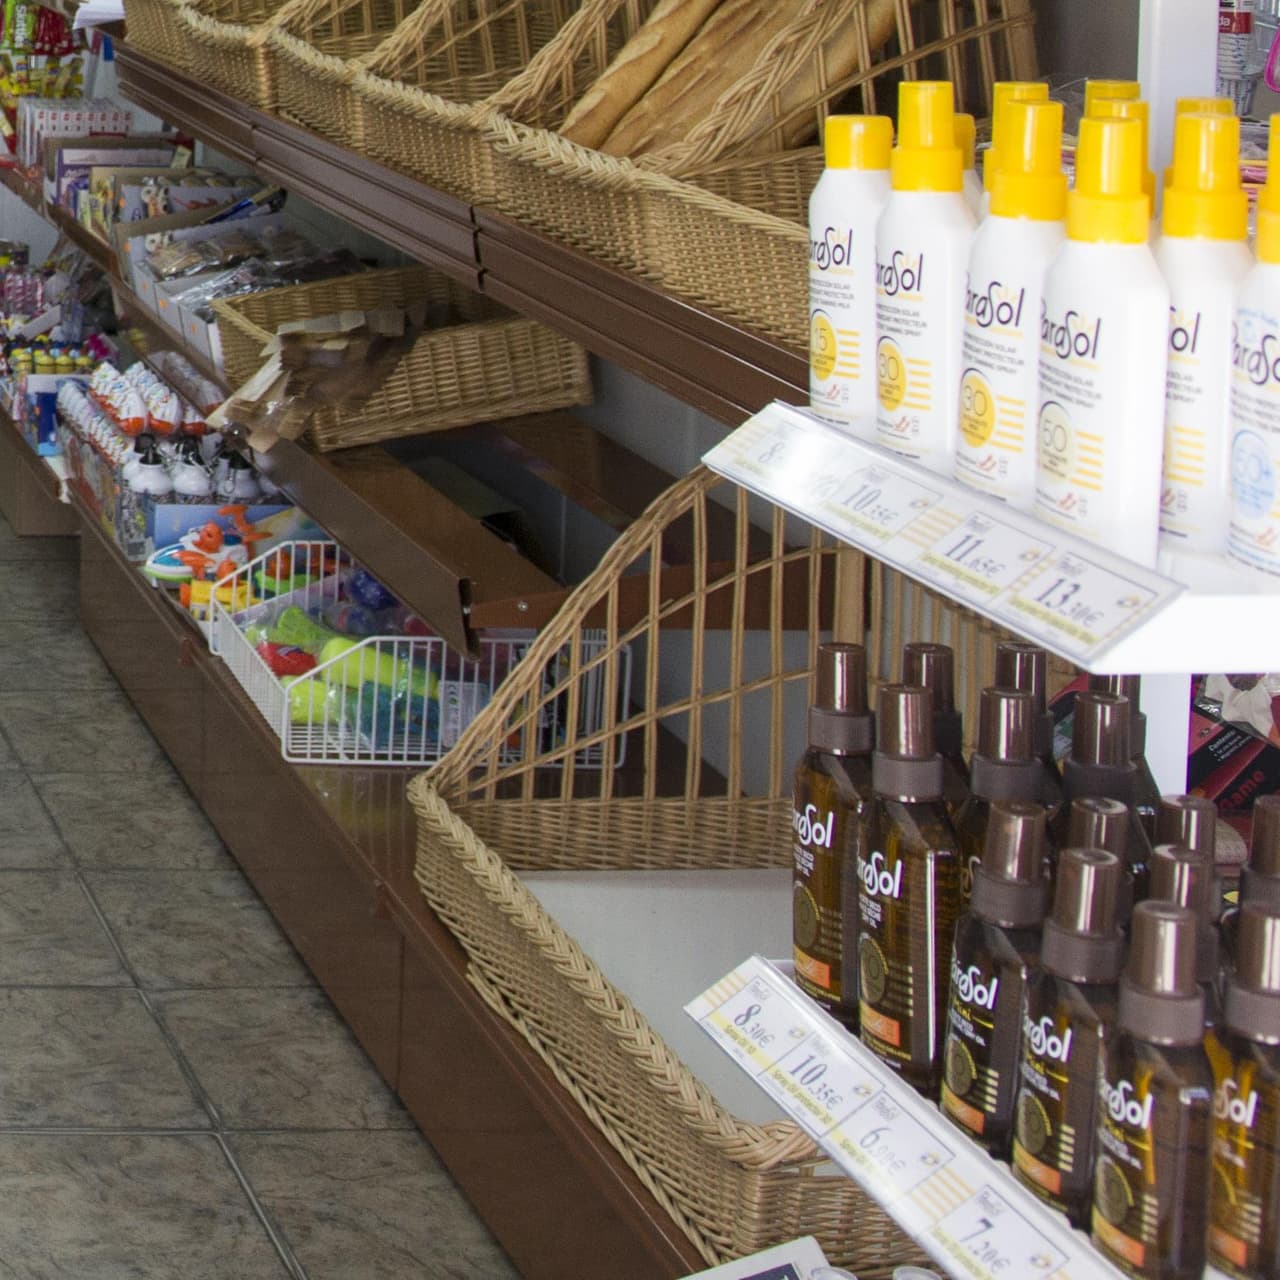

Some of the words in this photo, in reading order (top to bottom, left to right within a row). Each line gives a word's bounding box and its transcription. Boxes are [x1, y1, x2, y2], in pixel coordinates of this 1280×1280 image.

[879, 353, 900, 381] 30
[962, 384, 988, 417] 30
[1041, 419, 1068, 453] 50
